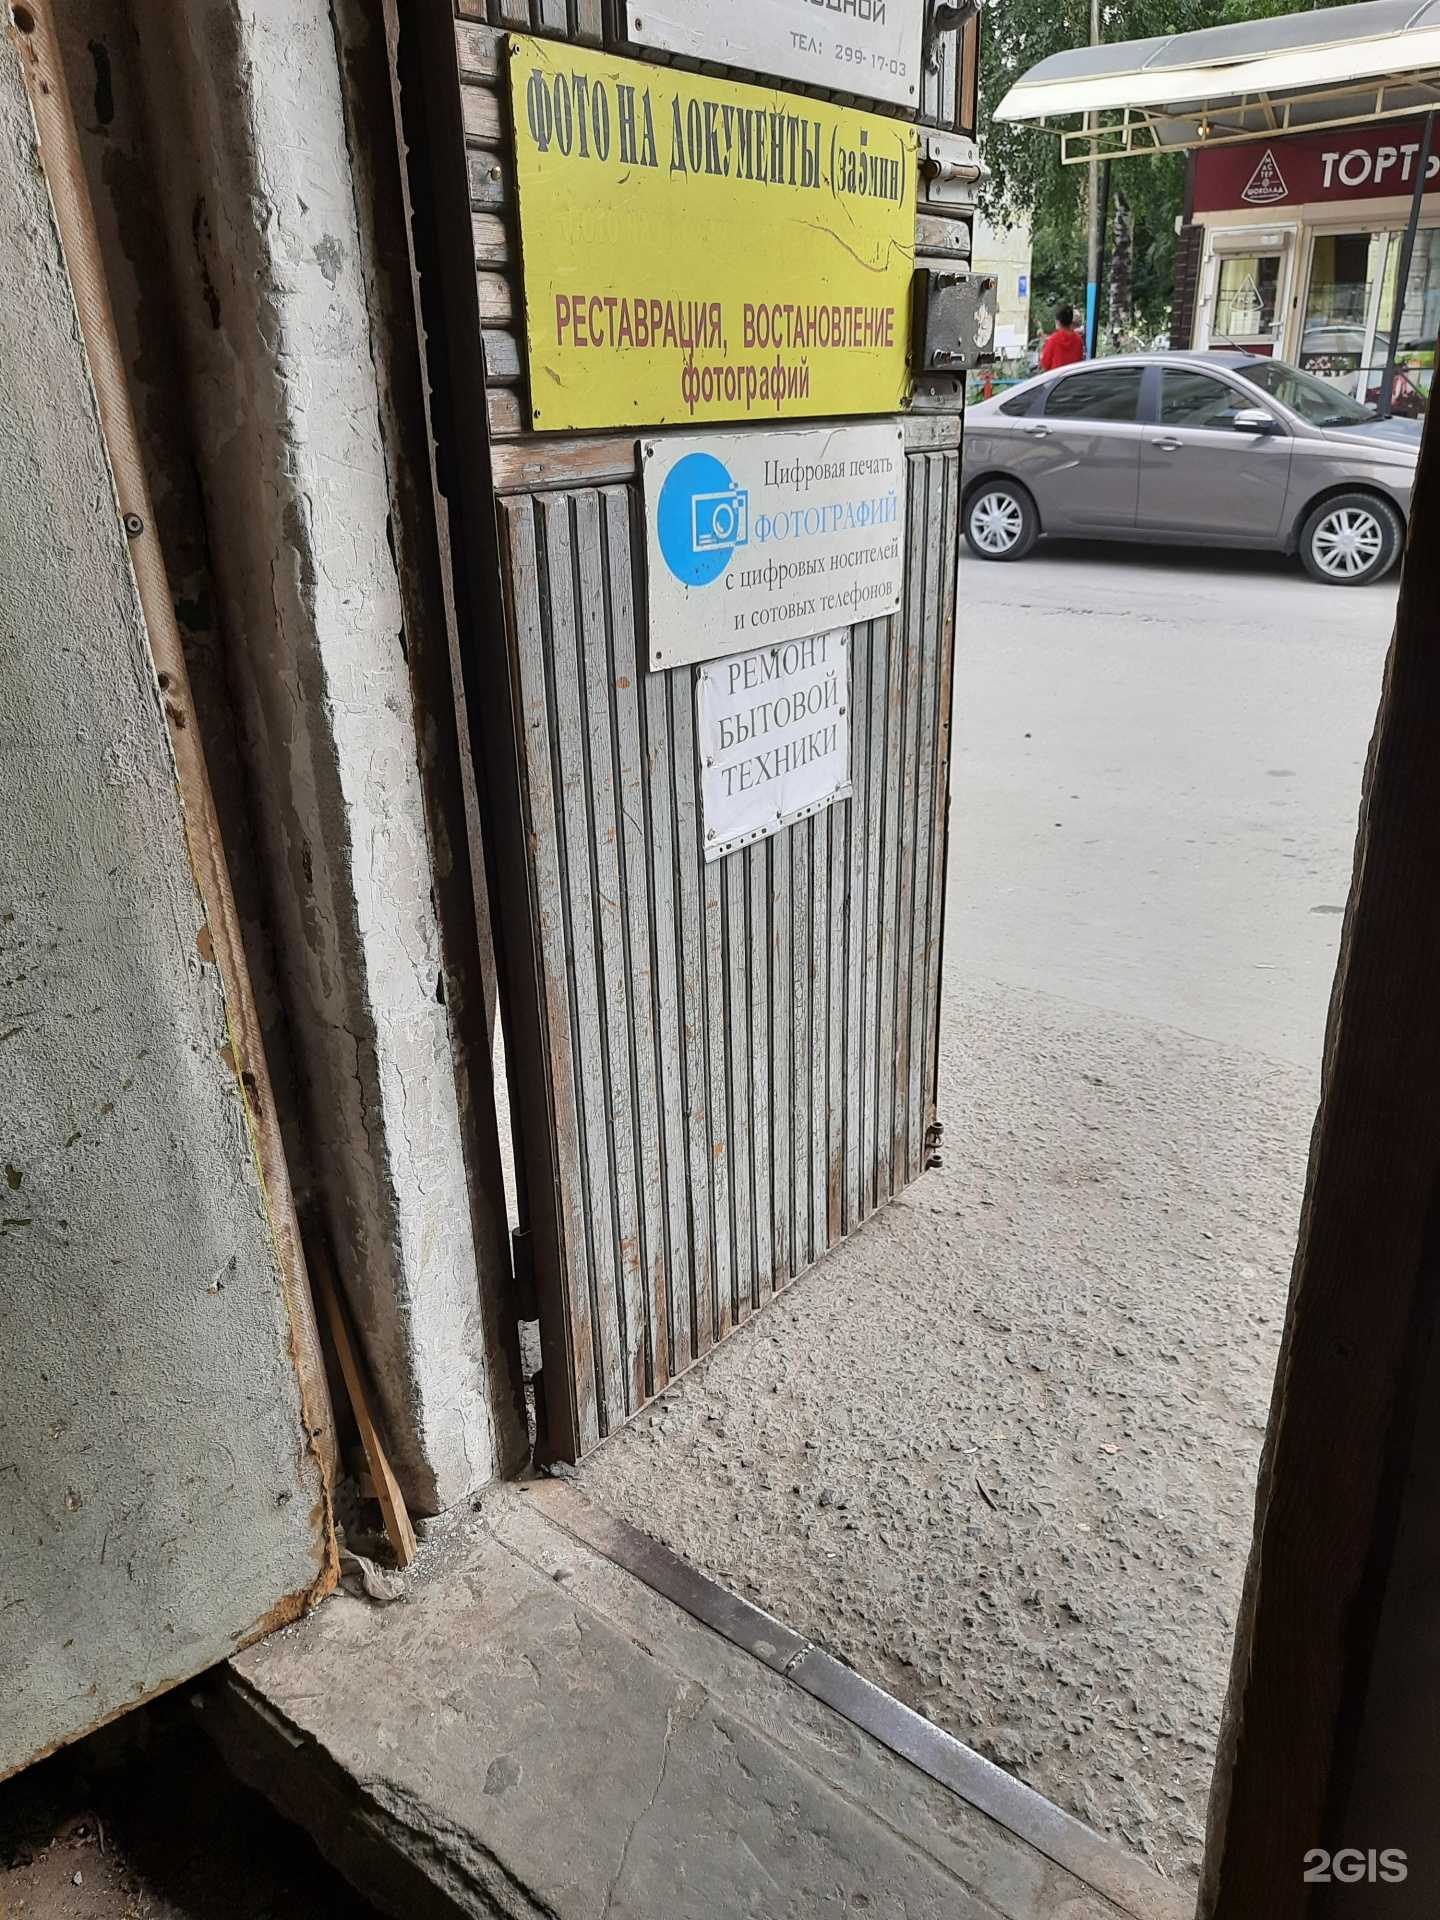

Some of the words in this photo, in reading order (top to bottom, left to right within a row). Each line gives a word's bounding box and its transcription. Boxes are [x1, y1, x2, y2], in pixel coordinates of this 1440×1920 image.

[790, 32, 822, 54] ТЕЛ:
[835, 44, 906, 76] 299-17-03
[527, 68, 610, 161] ФОТО
[616, 84, 658, 167] НА
[670, 92, 821, 188] ДОКУМЕНТЫ
[555, 294, 728, 357] РЕСТАВРАЦИЯ,
[743, 303, 895, 348] ВОСТАНОВЛЕНИЕ
[681, 354, 809, 415] фотографий
[764, 457, 845, 491] Цифровая
[850, 457, 893, 476] печать
[755, 489, 897, 543] ФОТОГРАФИЙ
[725, 573, 735, 590] с
[740, 557, 825, 591] цифровых
[830, 537, 898, 570] носителей
[734, 614, 745, 630] и
[751, 598, 815, 626] сотовых
[820, 580, 893, 611] телефонов
[728, 633, 831, 695] РЕМОНТ
[717, 670, 839, 750] БЫТОВОЙ
[721, 724, 837, 796] ТЕХНИКИ
